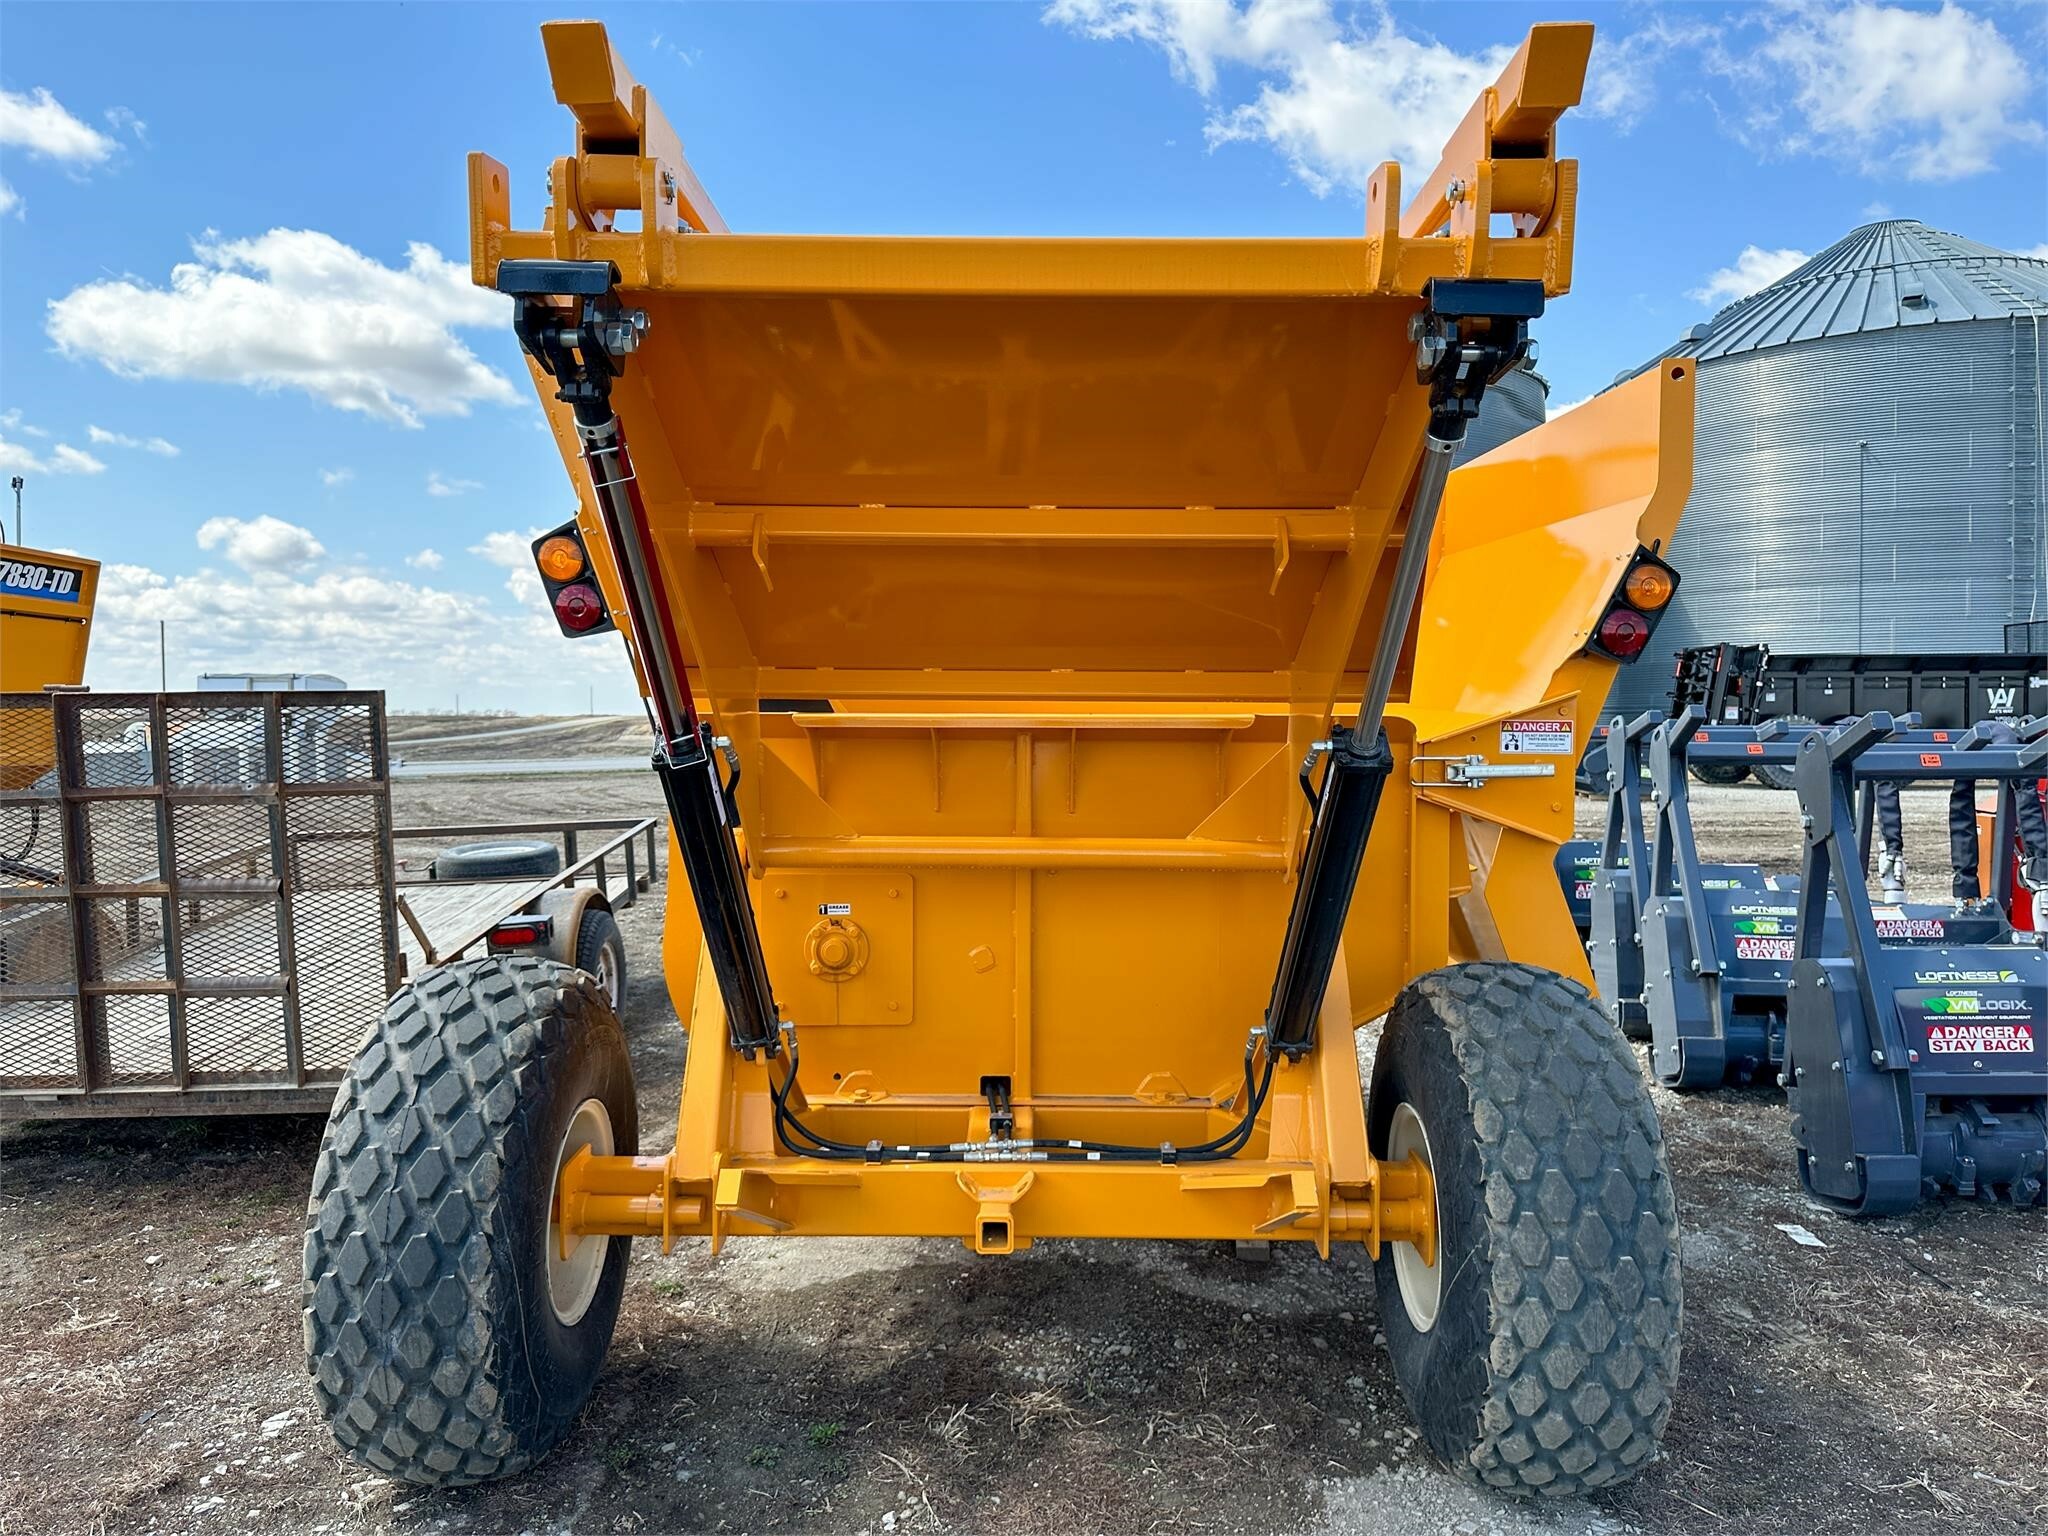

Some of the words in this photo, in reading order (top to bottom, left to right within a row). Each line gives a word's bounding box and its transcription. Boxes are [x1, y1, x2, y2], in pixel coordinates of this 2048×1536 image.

[0, 561, 75, 594] 7830-TD
[1513, 722, 1560, 732] DANGER
[1731, 905, 1798, 916] LOFTNESS
[1886, 920, 1933, 929] DANGER
[1878, 928, 1907, 937] STAY
[1911, 928, 1941, 937] BACK
[1749, 939, 1796, 950] DANGE
[1740, 949, 1775, 958] STAY
[1914, 971, 2000, 983] LOFTNESS
[1950, 1000, 2028, 1011] VMLOGIX
[1944, 1026, 2016, 1039] DANGER
[1932, 1040, 1977, 1051] STAY
[1983, 1039, 2031, 1051] BACK
